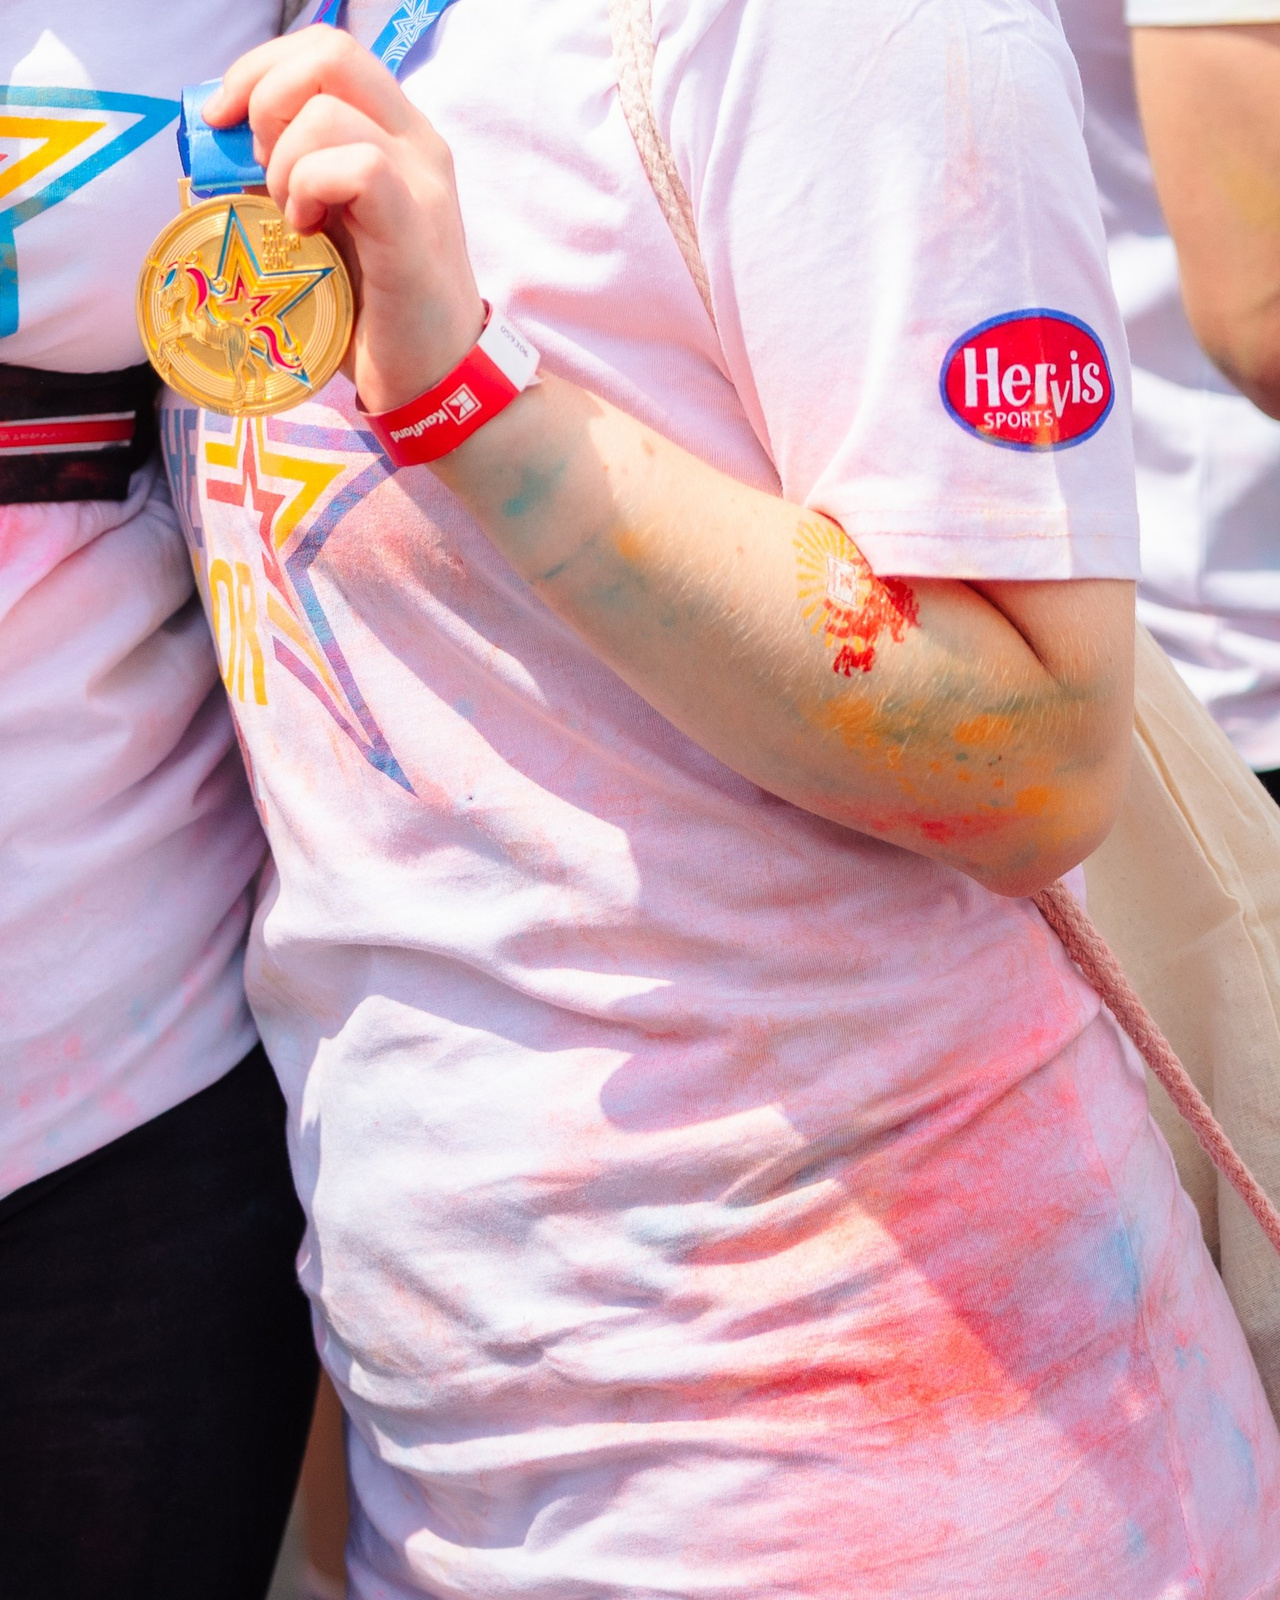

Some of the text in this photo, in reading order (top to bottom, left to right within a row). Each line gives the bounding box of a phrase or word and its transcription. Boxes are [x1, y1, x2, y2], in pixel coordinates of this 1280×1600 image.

[963, 347, 1104, 418] Hervis
[390, 408, 448, 443] Kaufland
[983, 410, 1054, 429] SPORTS
